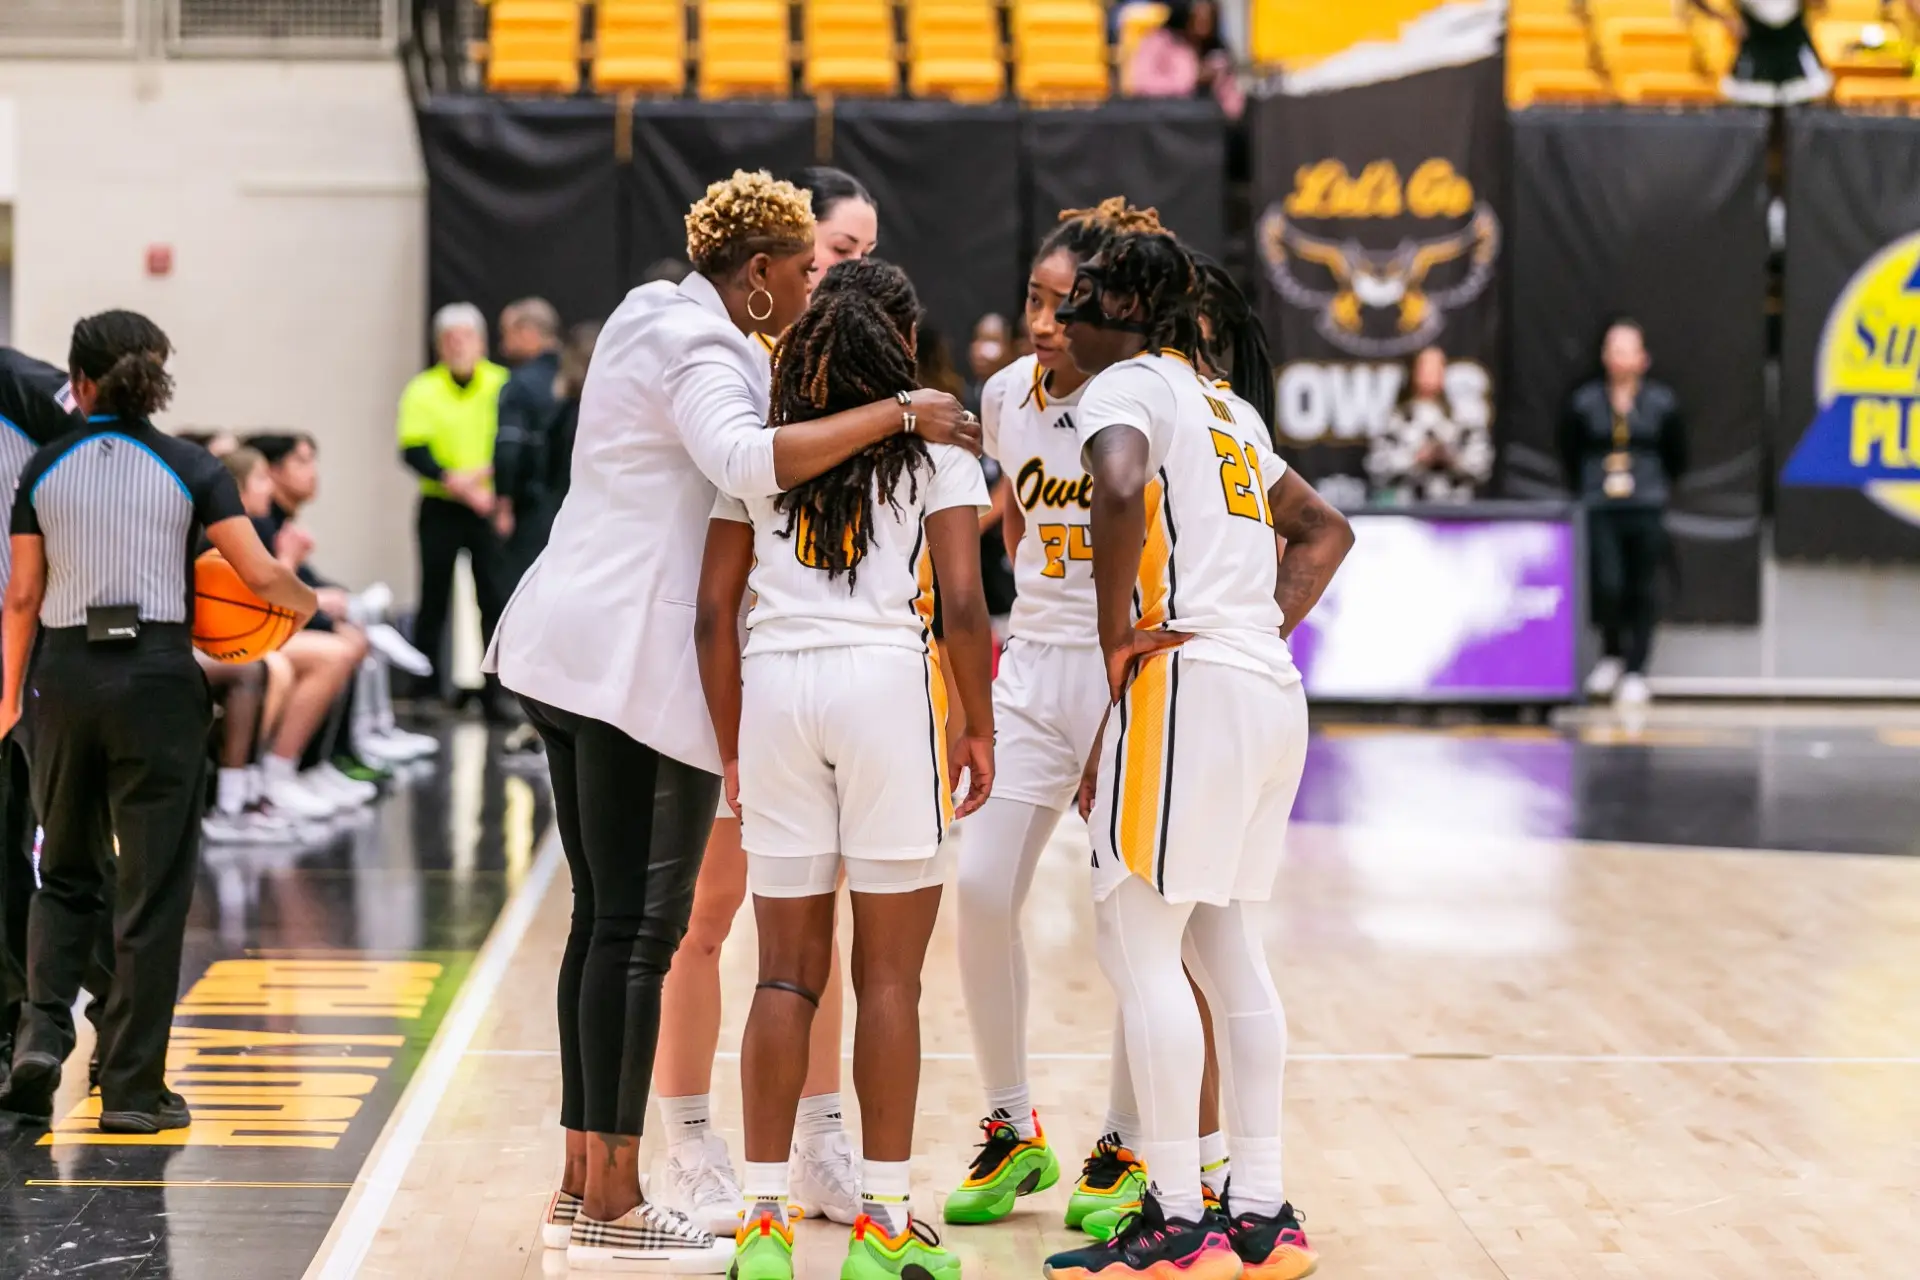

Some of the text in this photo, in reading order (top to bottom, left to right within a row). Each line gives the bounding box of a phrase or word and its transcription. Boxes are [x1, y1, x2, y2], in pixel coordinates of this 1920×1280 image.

[1844, 306, 1920, 388] Su
[1276, 362, 1490, 440] OWS
[1016, 456, 1093, 512] Owl
[1208, 426, 1275, 529] 21
